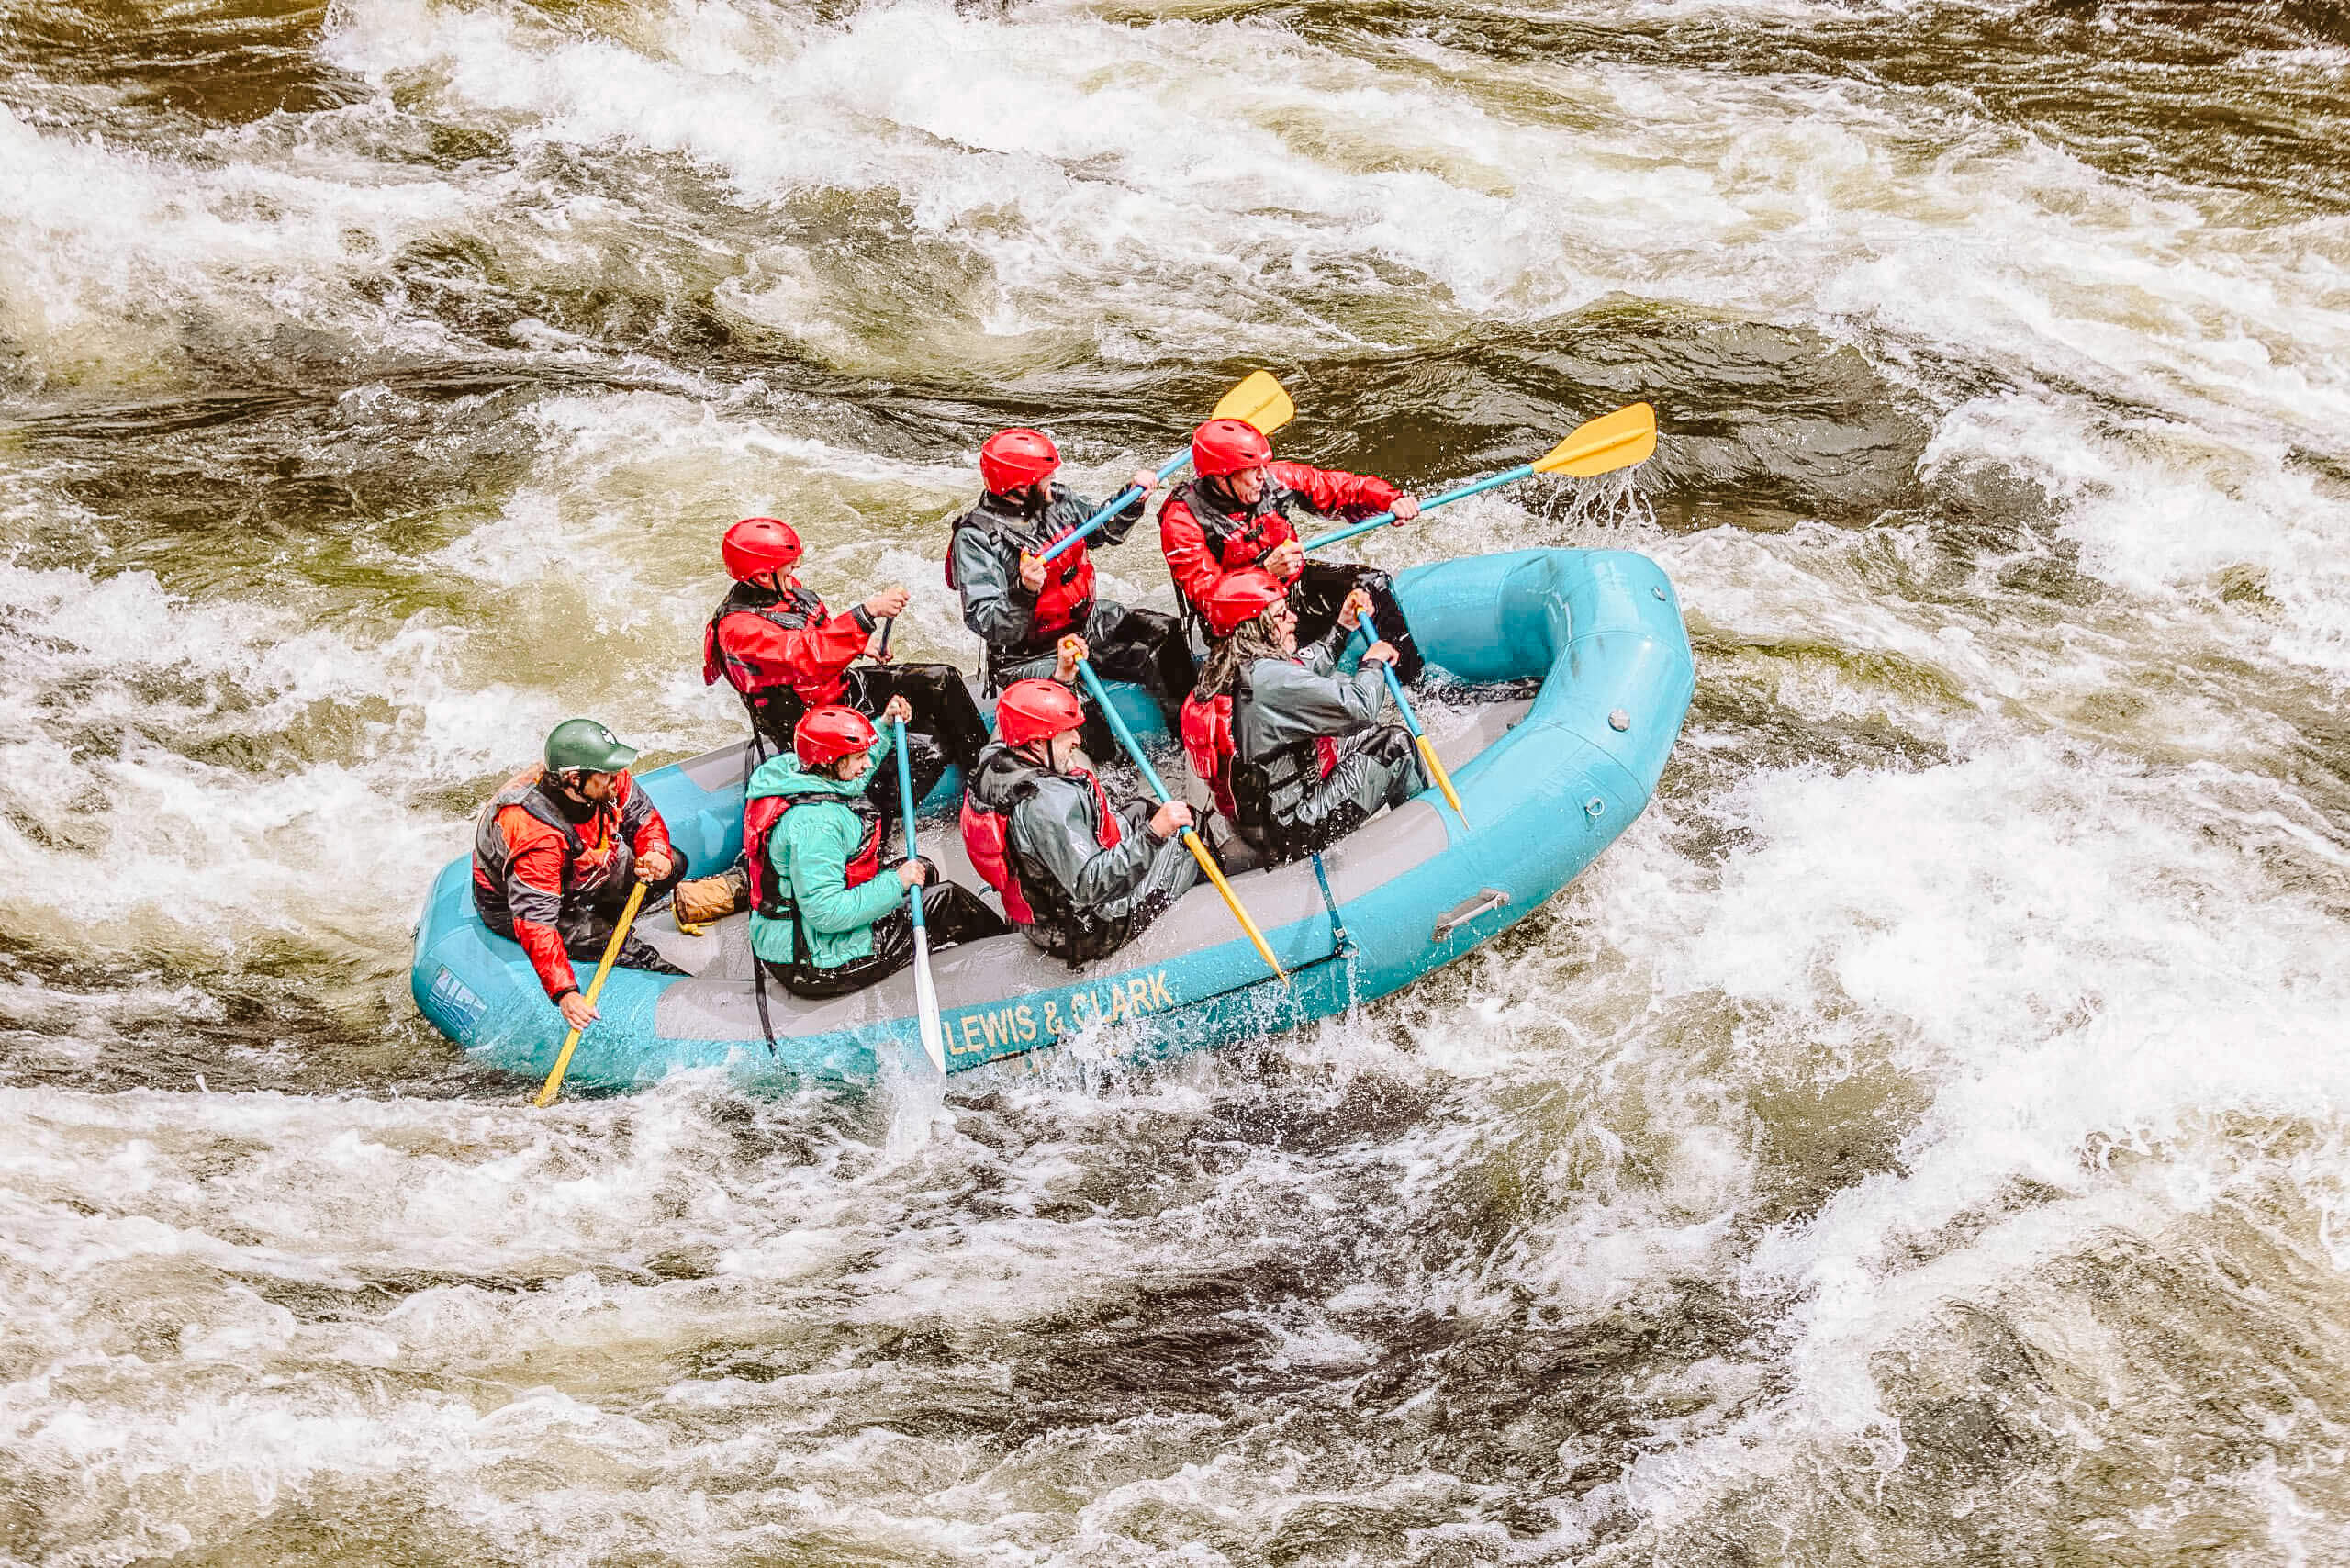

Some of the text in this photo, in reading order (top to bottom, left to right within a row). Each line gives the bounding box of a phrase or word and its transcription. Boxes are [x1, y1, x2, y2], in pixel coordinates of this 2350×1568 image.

[943, 969, 1174, 1056] LEWIS & CLARK
